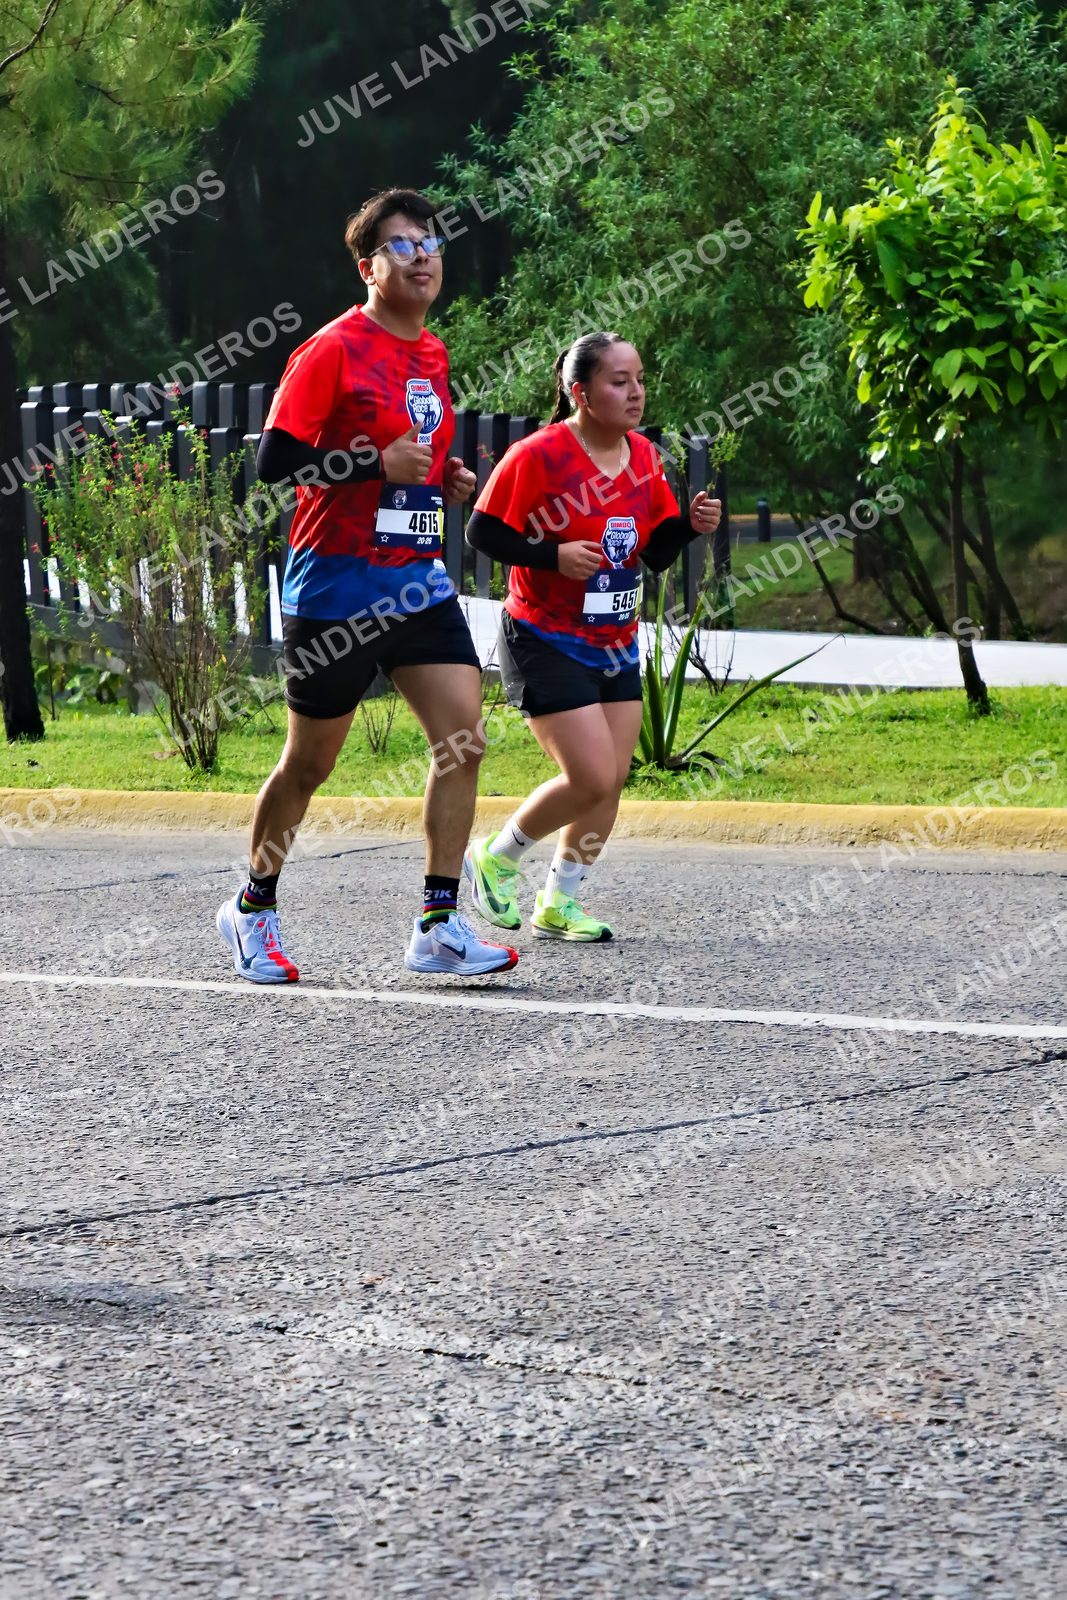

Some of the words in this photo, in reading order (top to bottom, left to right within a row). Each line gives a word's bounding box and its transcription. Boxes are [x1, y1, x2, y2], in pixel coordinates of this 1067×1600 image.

[408, 512, 438, 533] 4615
[249, 881, 269, 896] 1K
[424, 889, 452, 901] 21K
